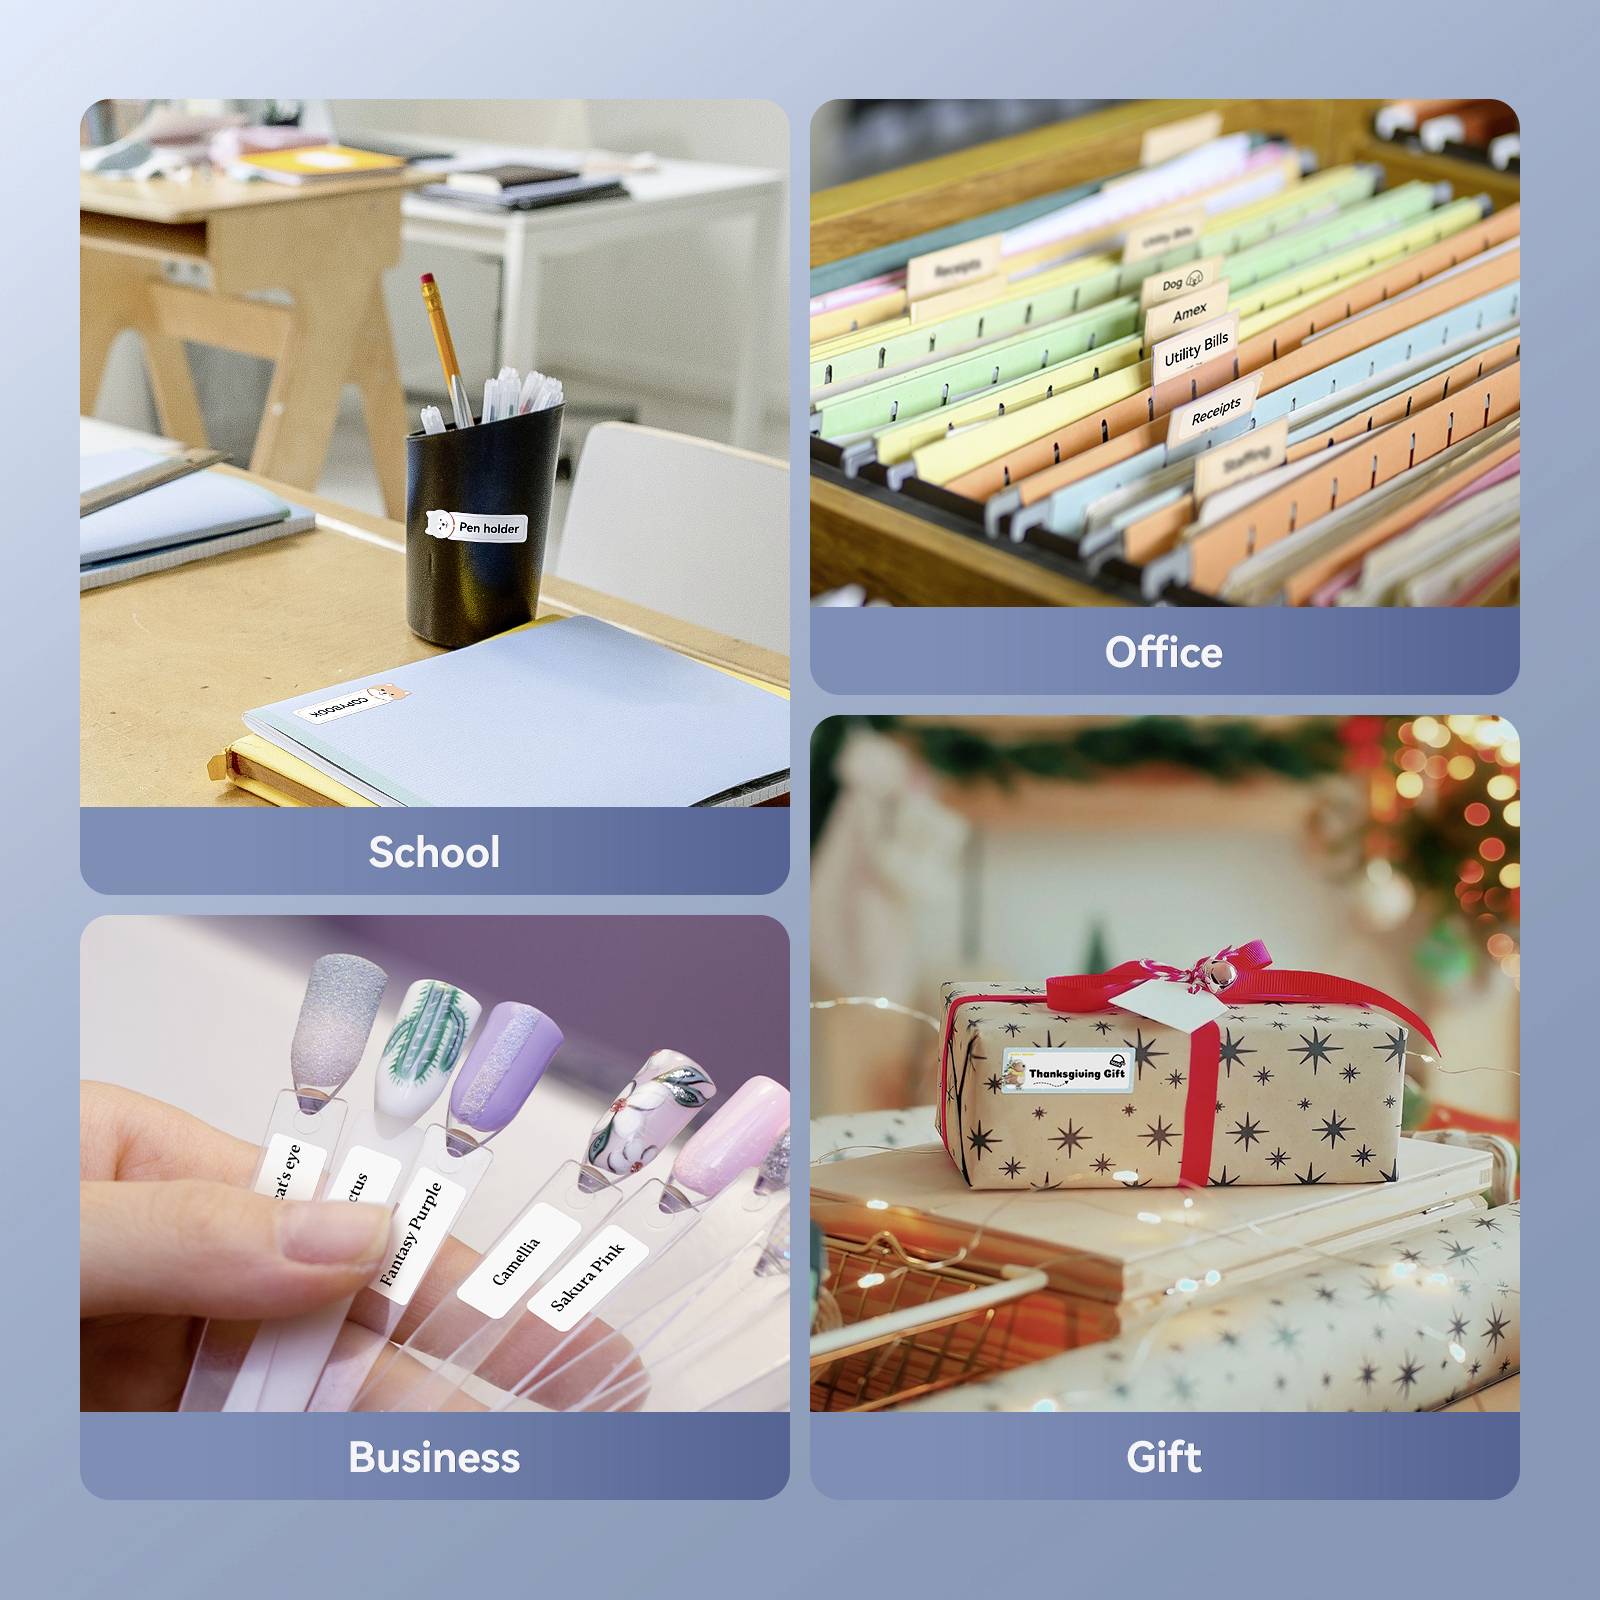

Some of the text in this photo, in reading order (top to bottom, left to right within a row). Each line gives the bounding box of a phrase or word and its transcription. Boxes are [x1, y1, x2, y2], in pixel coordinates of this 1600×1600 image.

[1163, 279, 1182, 291] Dog
[1173, 303, 1207, 323] Amex
[1165, 332, 1229, 366] Utility Bills
[1192, 397, 1241, 426] Receipts
[459, 521, 520, 534] Pen holder
[310, 697, 369, 718] COPYBOOK
[1029, 1069, 1126, 1080] Thanksgiving Gift
[286, 1144, 301, 1170] eye
[348, 1172, 368, 1203] ctus
[379, 1181, 442, 1287] Fantasy Purple
[492, 1238, 541, 1286] Camellia
[550, 1243, 626, 1312] Sakura Pink
